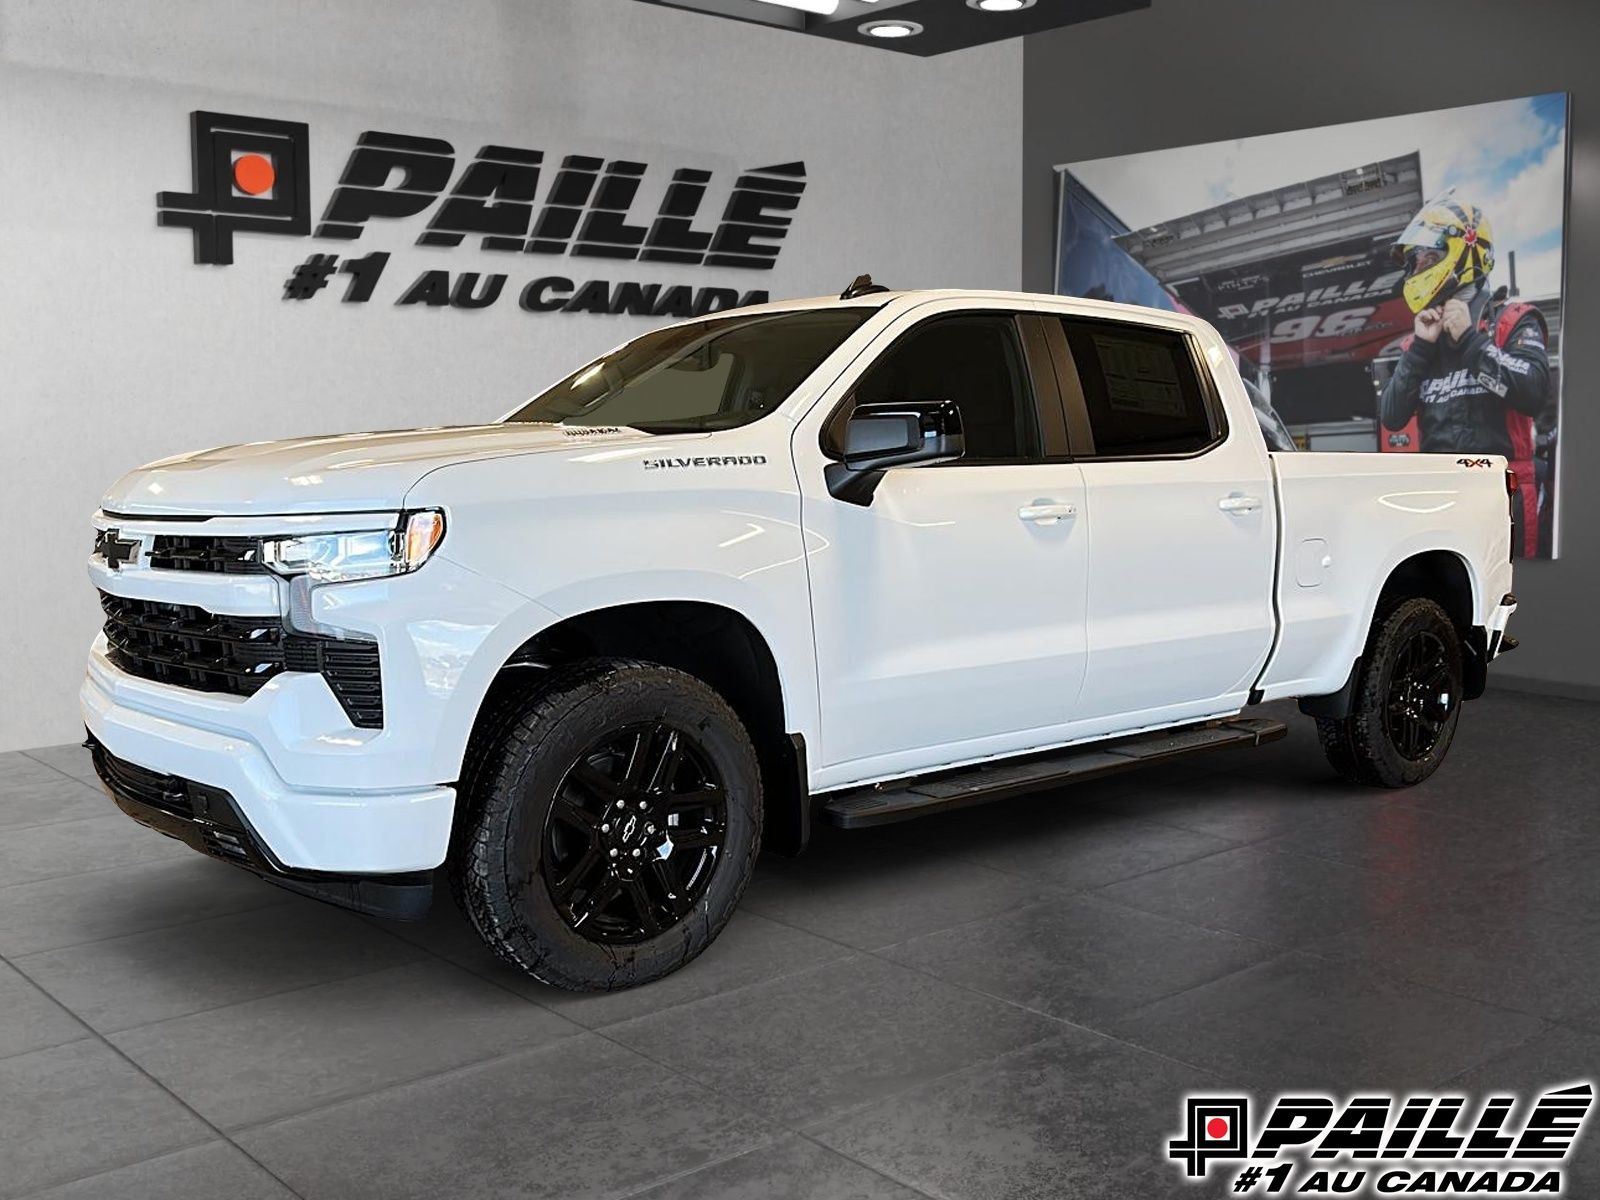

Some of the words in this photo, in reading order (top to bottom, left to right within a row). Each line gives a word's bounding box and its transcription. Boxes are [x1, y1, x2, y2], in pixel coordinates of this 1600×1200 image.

[312, 130, 807, 270] PAILLÉ
[281, 251, 391, 305] #1
[394, 269, 508, 310] AU
[1270, 306, 1377, 344] 96
[642, 455, 768, 470] SILVERADO
